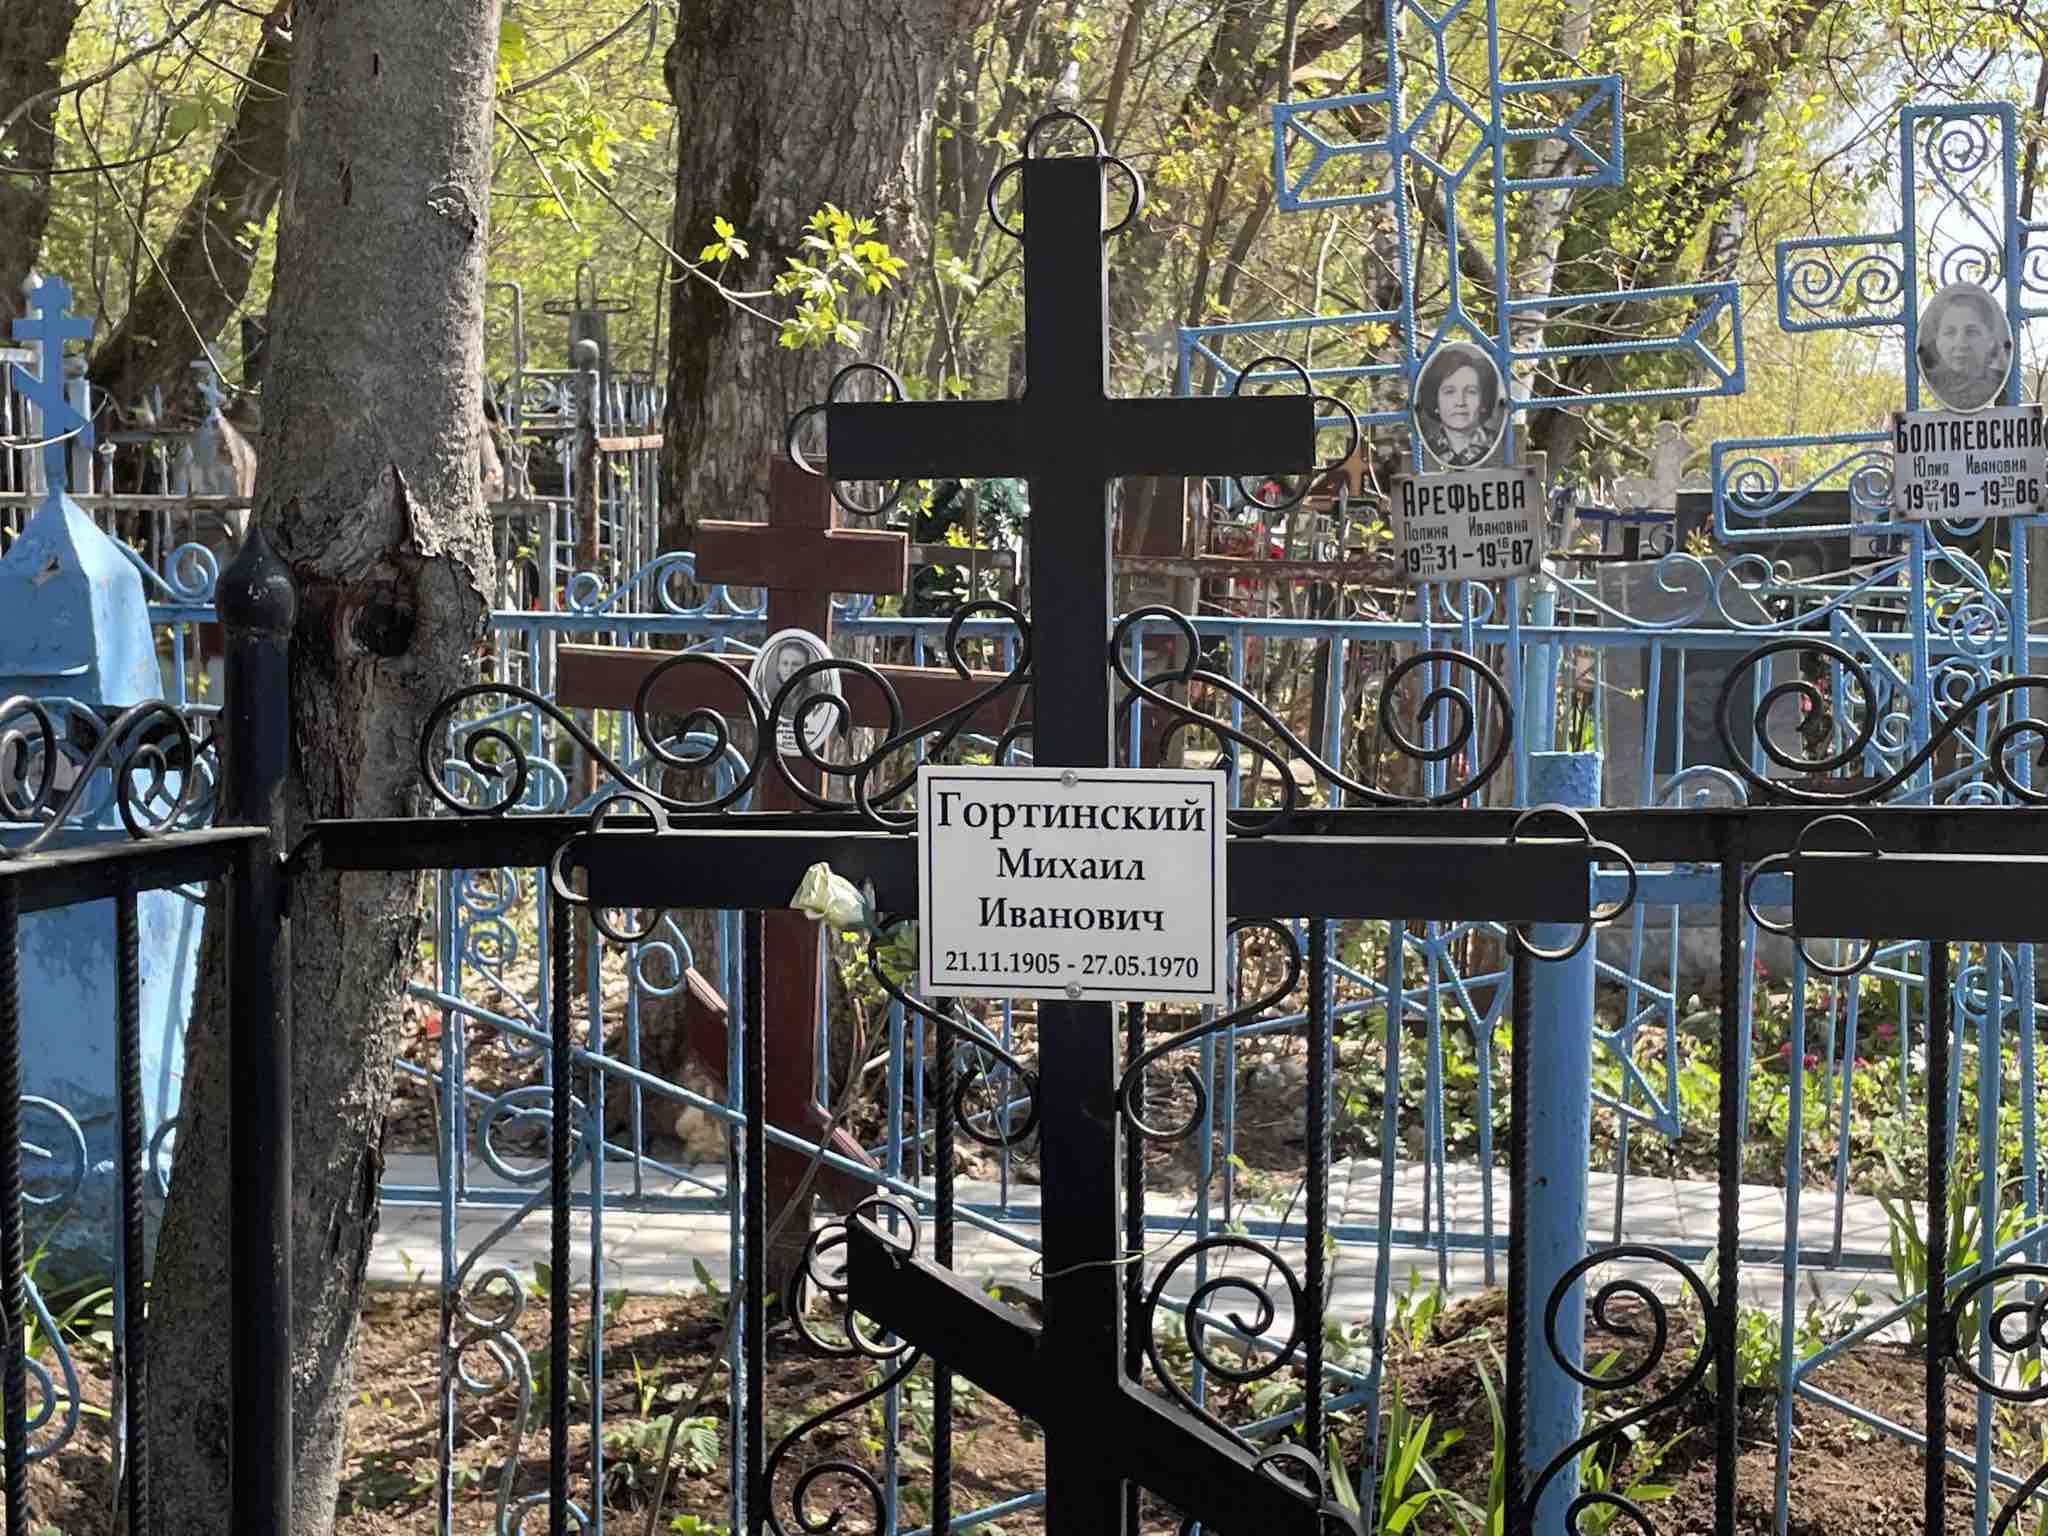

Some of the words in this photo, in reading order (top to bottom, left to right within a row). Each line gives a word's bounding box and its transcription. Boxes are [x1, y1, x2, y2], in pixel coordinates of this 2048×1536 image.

[1896, 417, 2041, 453] БОЛТАЕВСКАЯ
[1403, 480, 1525, 517] АРЕФЬЕВА
[937, 792, 1205, 839] Гортинский
[996, 848, 1145, 880] Михаил
[978, 897, 1165, 931] Иванович
[945, 951, 1060, 974] 21.11.1905
[1082, 954, 1198, 978] 27.05.1970
